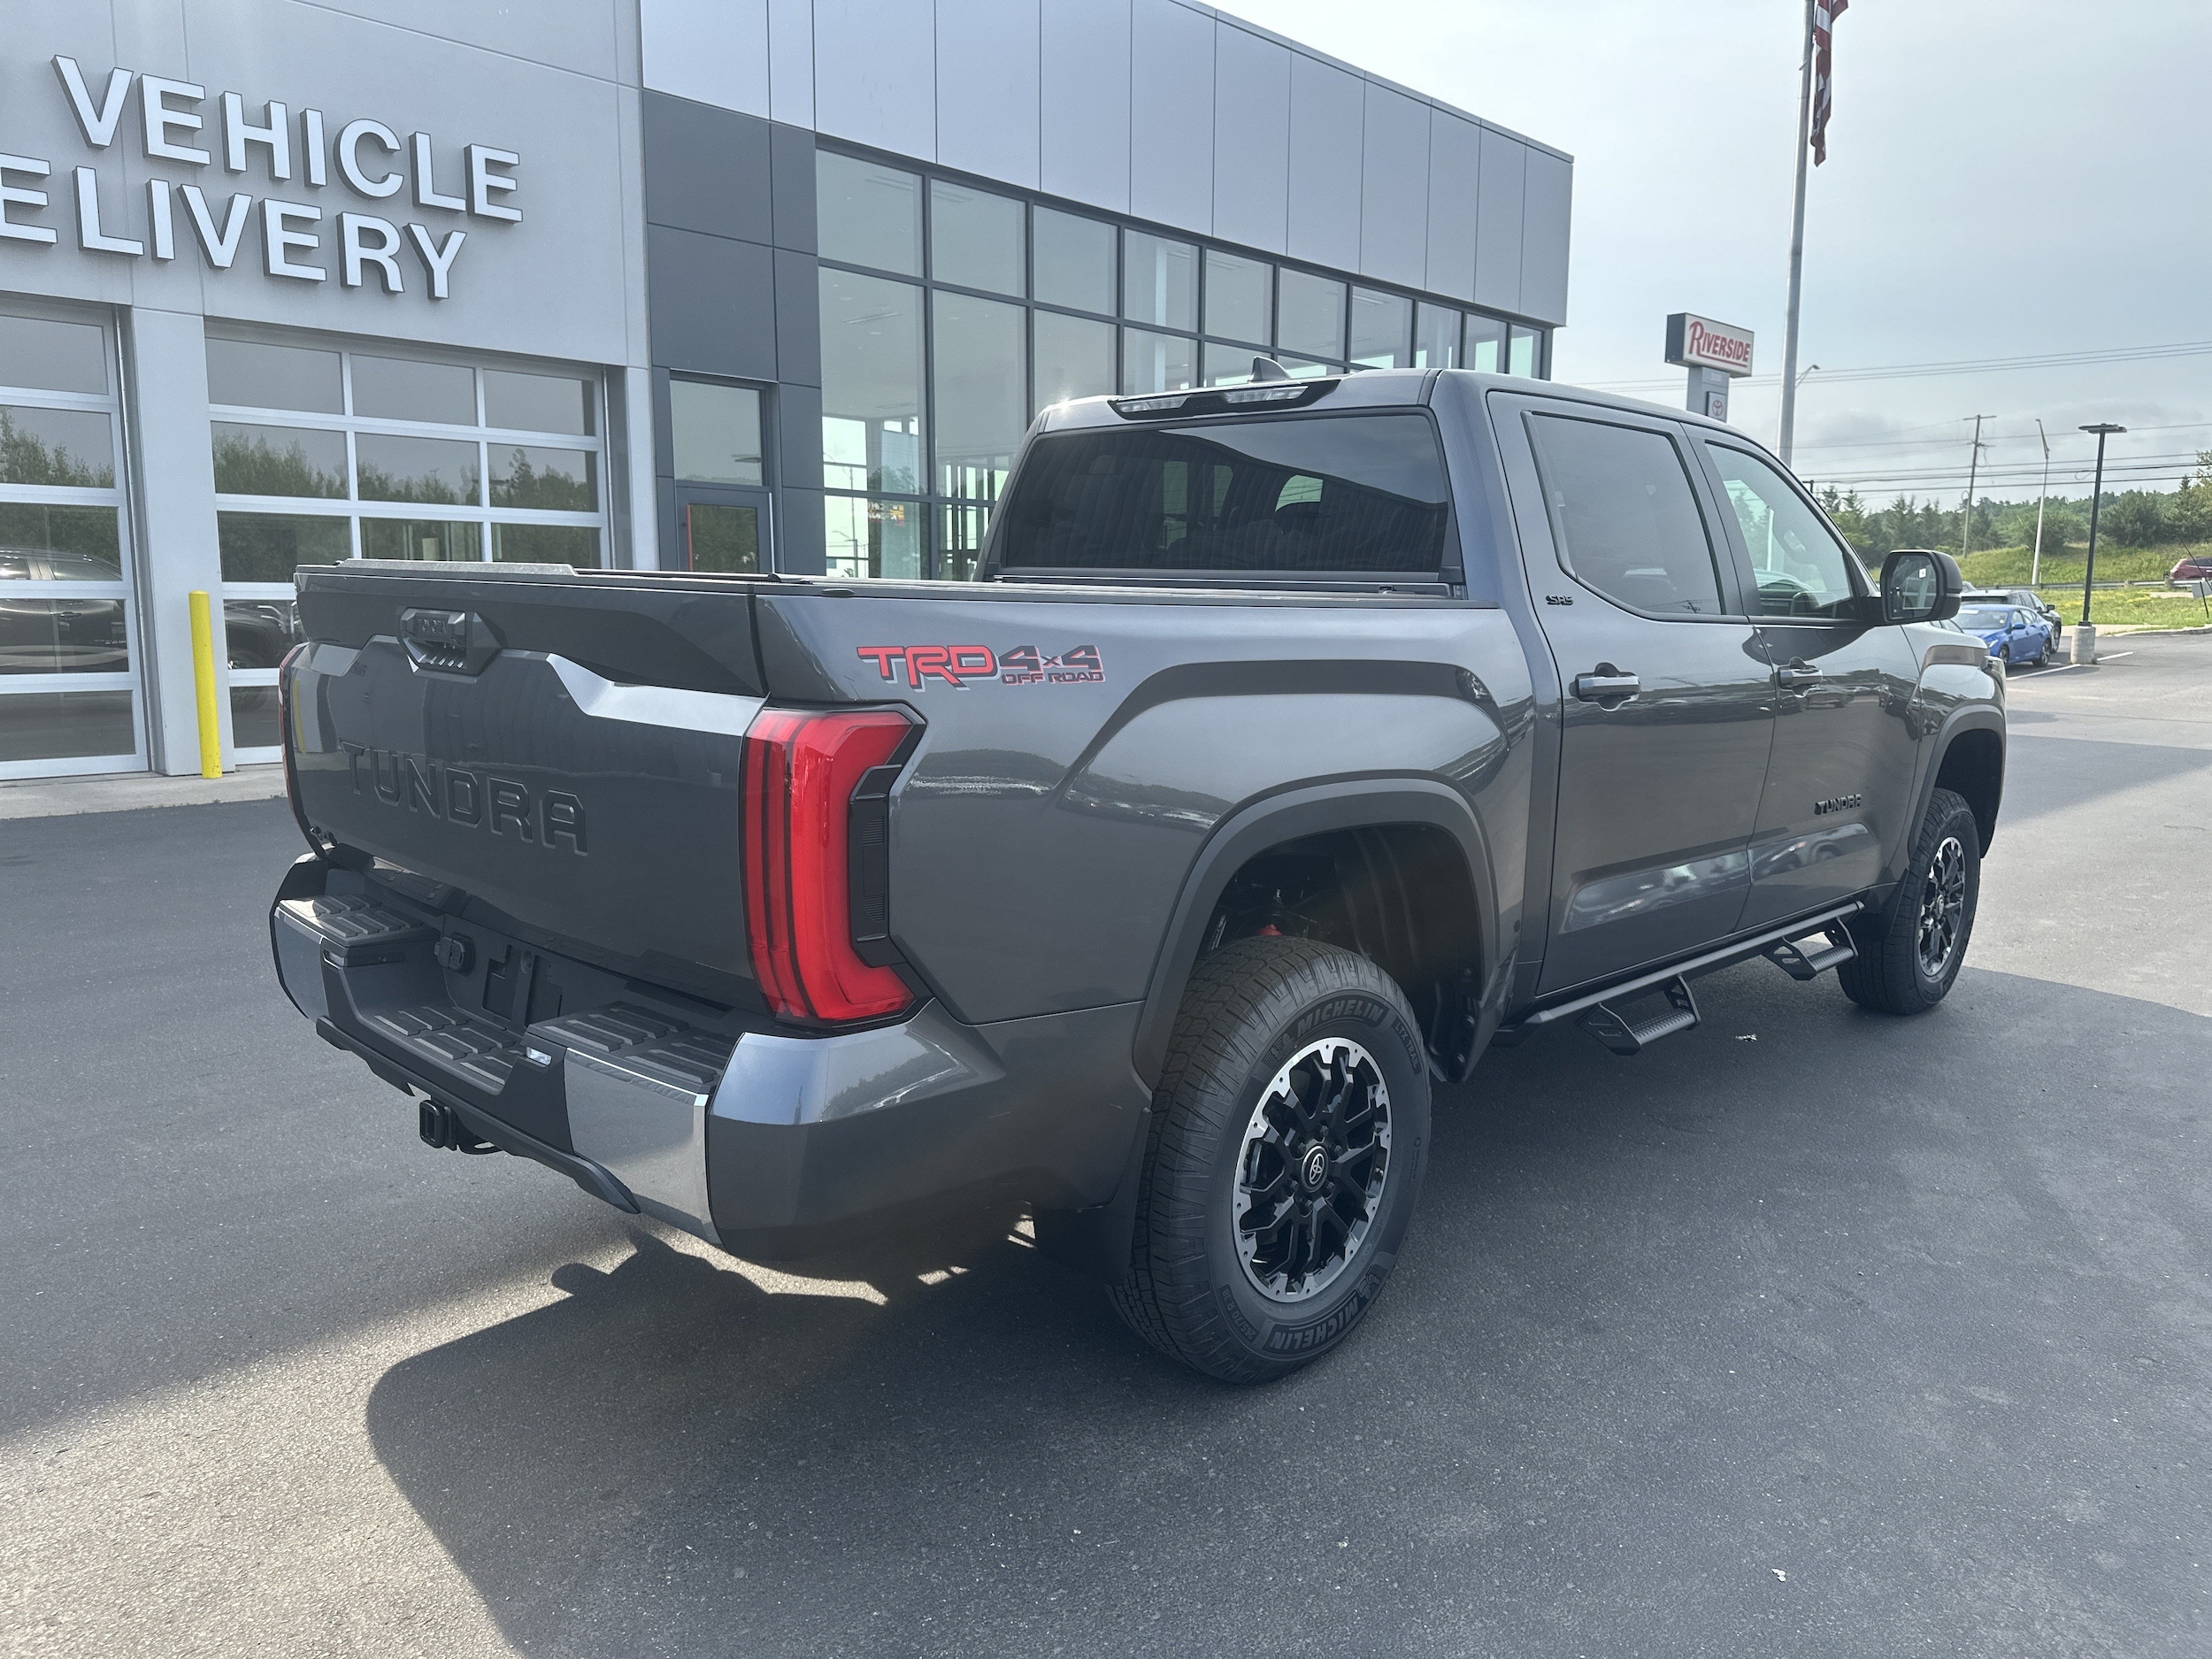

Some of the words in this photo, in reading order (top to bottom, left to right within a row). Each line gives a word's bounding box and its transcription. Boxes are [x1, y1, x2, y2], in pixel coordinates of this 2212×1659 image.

[51, 54, 523, 224] VEHICLE
[1688, 321, 1751, 364] RIVERSIDE
[1546, 595, 1574, 605] SR5
[856, 644, 1001, 692] TRD
[1001, 672, 1045, 686] OFF
[1047, 671, 1106, 684] ROAD
[339, 737, 588, 856] TUNDRA
[1814, 794, 1862, 815] TUNDRA
[1296, 999, 1385, 1038] MICHELIN
[1394, 1022, 1409, 1042] LTX
[1405, 1039, 1419, 1069] TRAIL
[1268, 1296, 1360, 1349] MICHELIN
